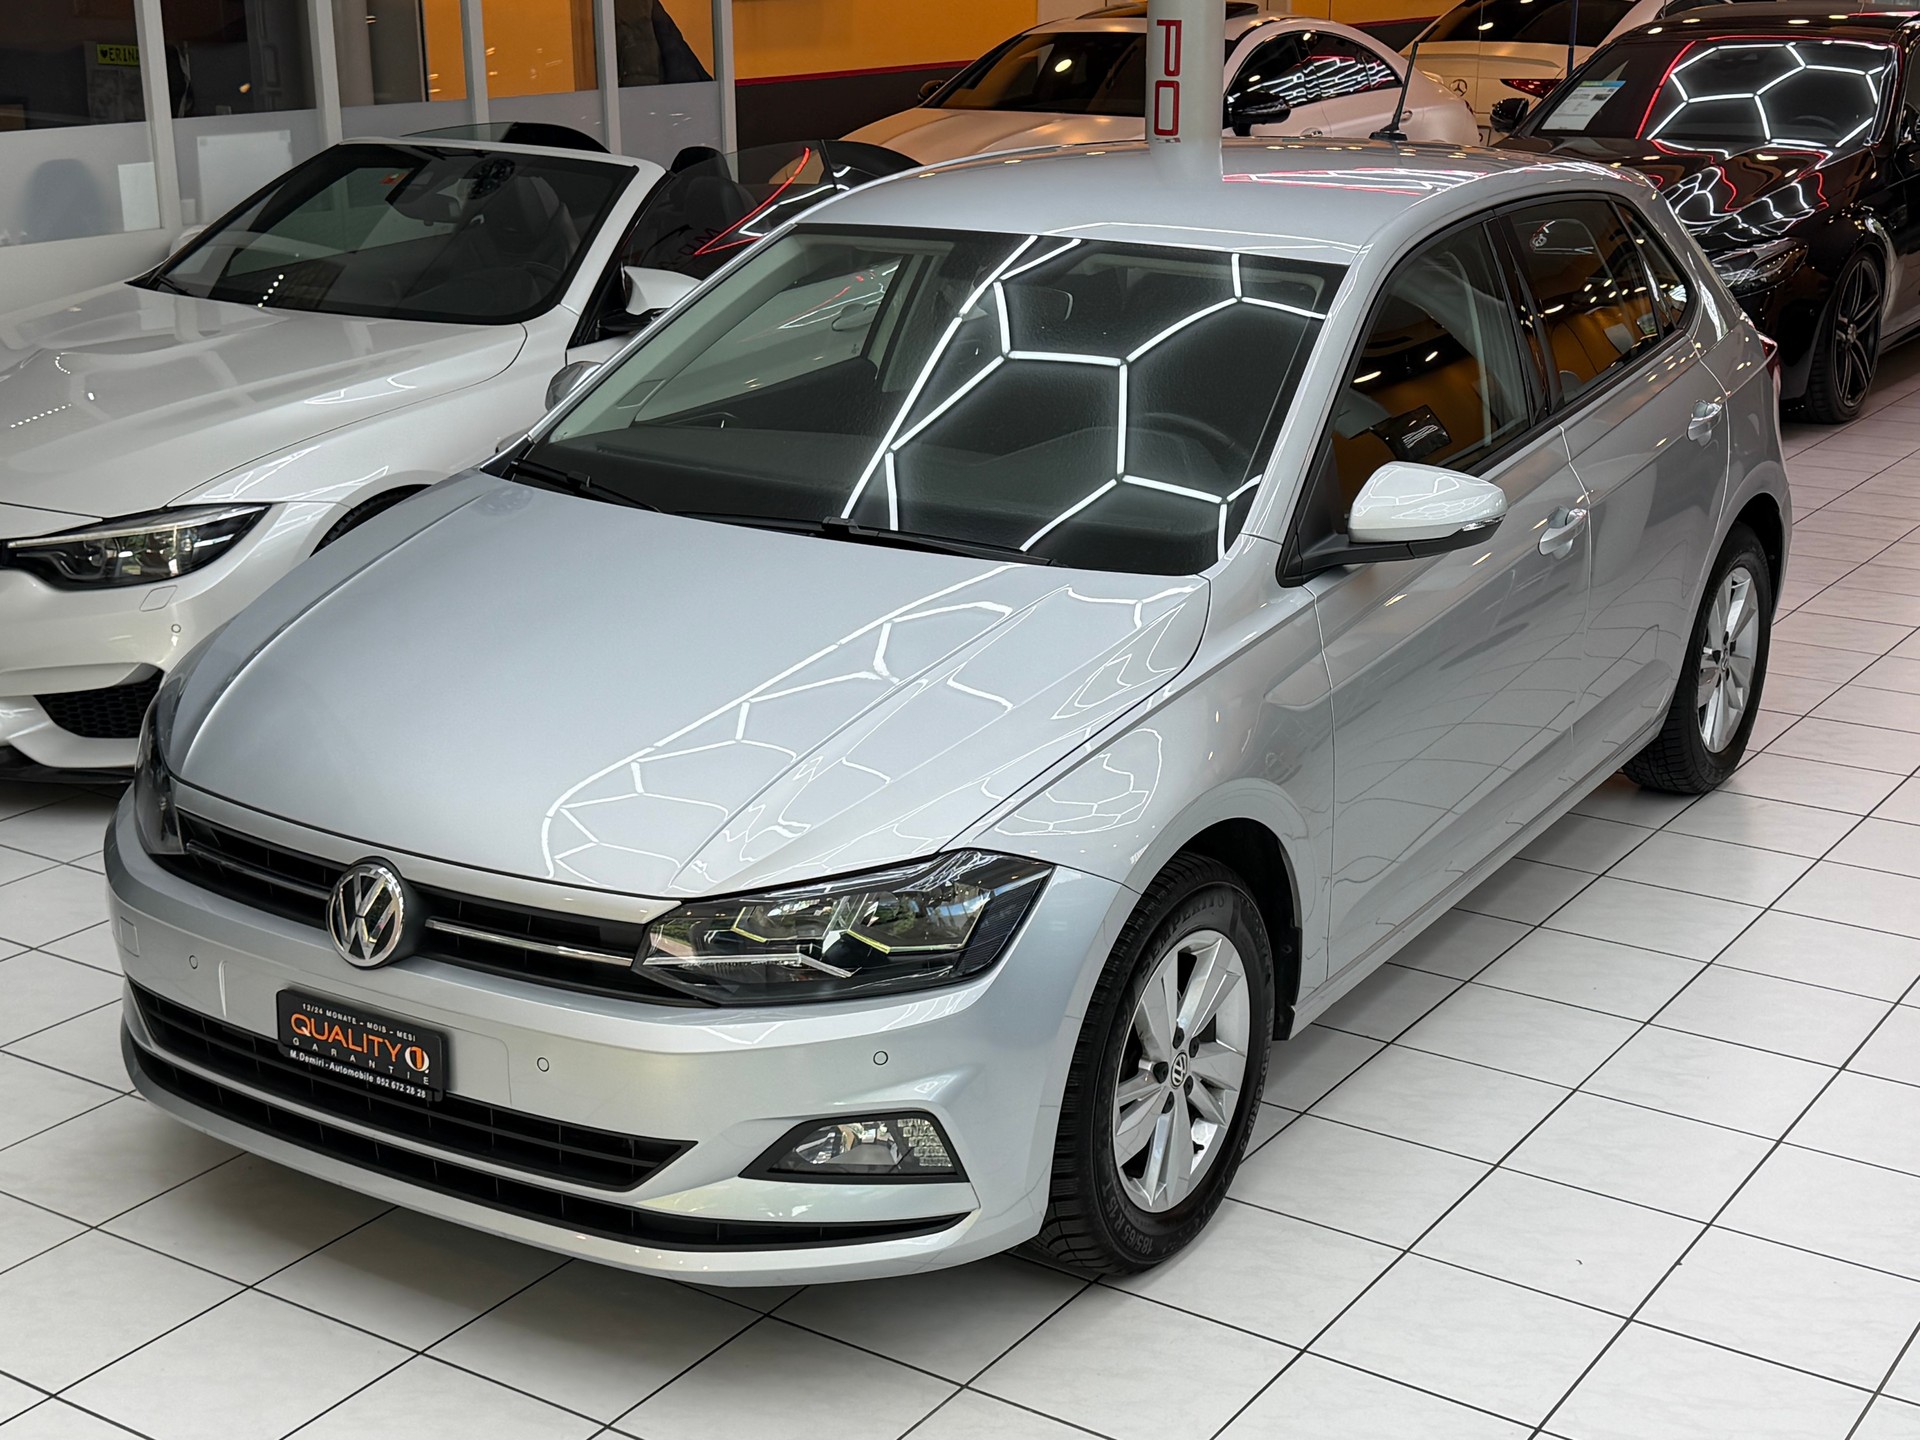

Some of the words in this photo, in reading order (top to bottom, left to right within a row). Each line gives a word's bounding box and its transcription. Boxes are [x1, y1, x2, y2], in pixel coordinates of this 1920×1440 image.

[1154, 19, 1182, 142] PO
[291, 1013, 402, 1062] QUALITY
[302, 1003, 323, 1014] 12/24
[326, 1010, 357, 1025] MONATE
[366, 1022, 387, 1034] MOIS
[396, 1030, 416, 1042] MESI
[292, 1037, 429, 1085] GARANTIE
[376, 1076, 389, 1087] 052
[391, 1081, 405, 1092] 672
[406, 1086, 415, 1095] 28
[417, 1089, 426, 1098] 28
